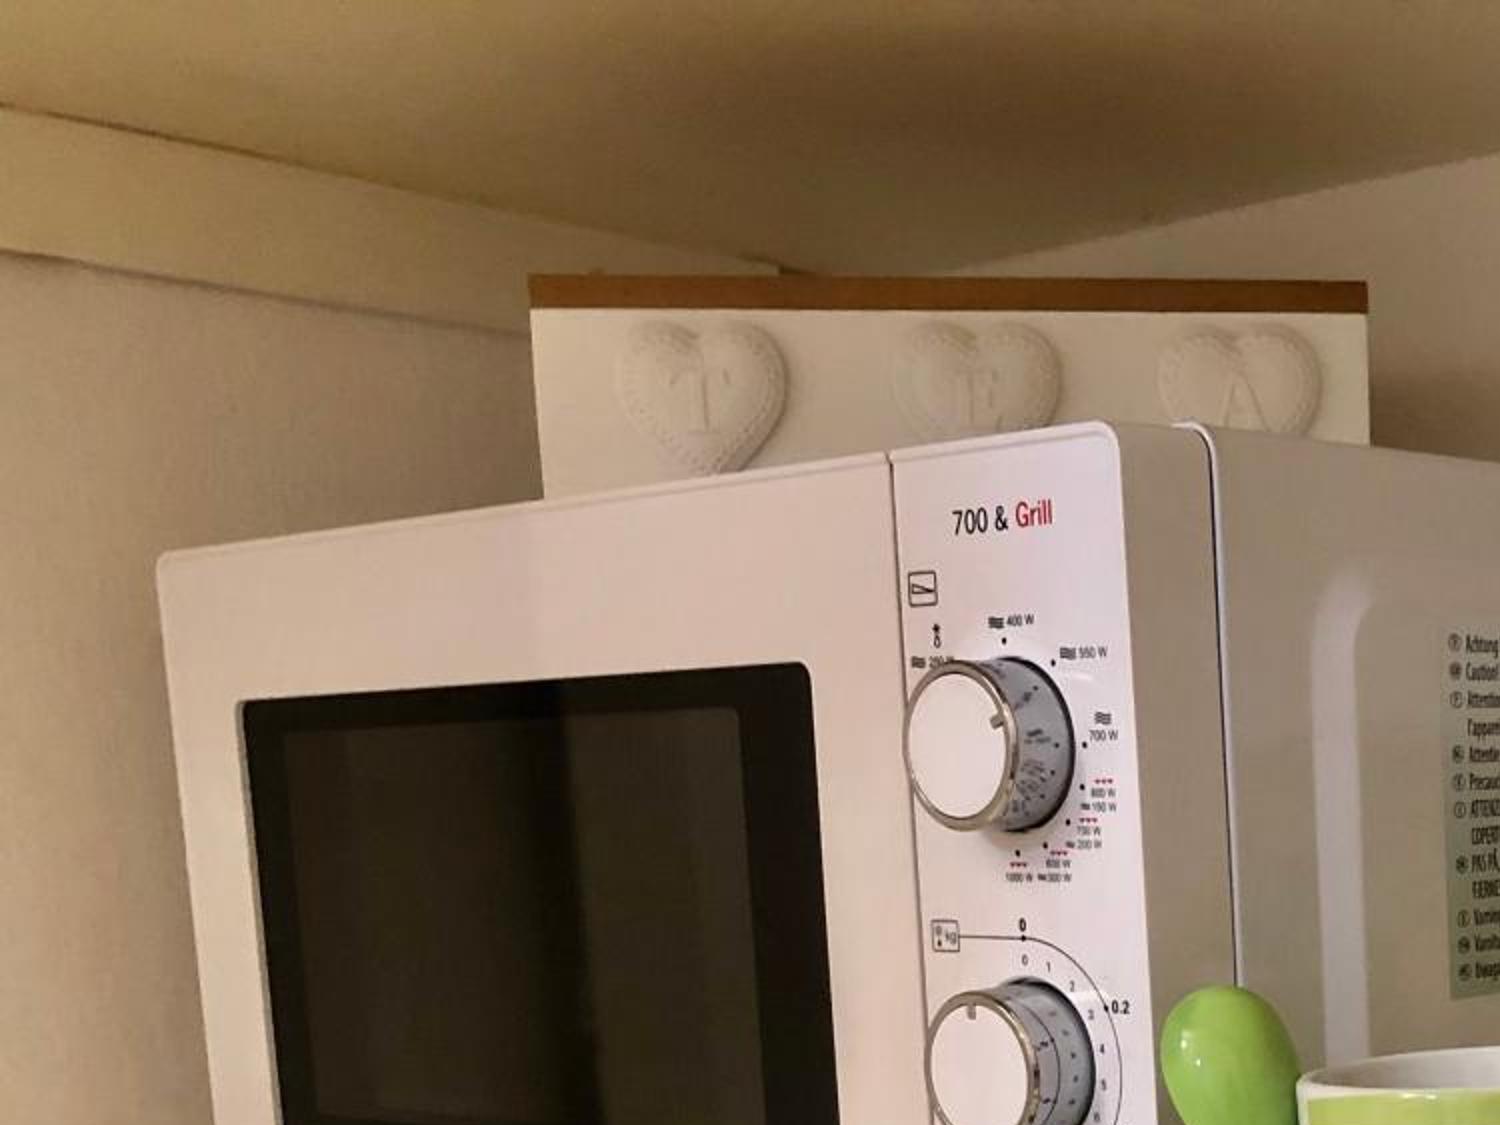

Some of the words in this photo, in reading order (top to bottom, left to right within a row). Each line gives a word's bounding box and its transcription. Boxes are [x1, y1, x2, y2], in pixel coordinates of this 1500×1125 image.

[952, 507, 989, 535] 700
[995, 505, 1009, 531] &
[1015, 499, 1054, 528] Grill
[1006, 615, 1022, 627] 400
[1024, 613, 1034, 625] W
[1098, 646, 1108, 657] W
[1466, 633, 1499, 658] Achtung
[1466, 661, 1499, 681] Caution!
[1089, 730, 1106, 742] 700
[1108, 729, 1119, 741] W
[1018, 917, 1028, 933] 0
[1021, 953, 1029, 967] 0
[1046, 961, 1052, 973] 1
[1069, 980, 1076, 993] 2
[1111, 1000, 1131, 1016] 0.2
